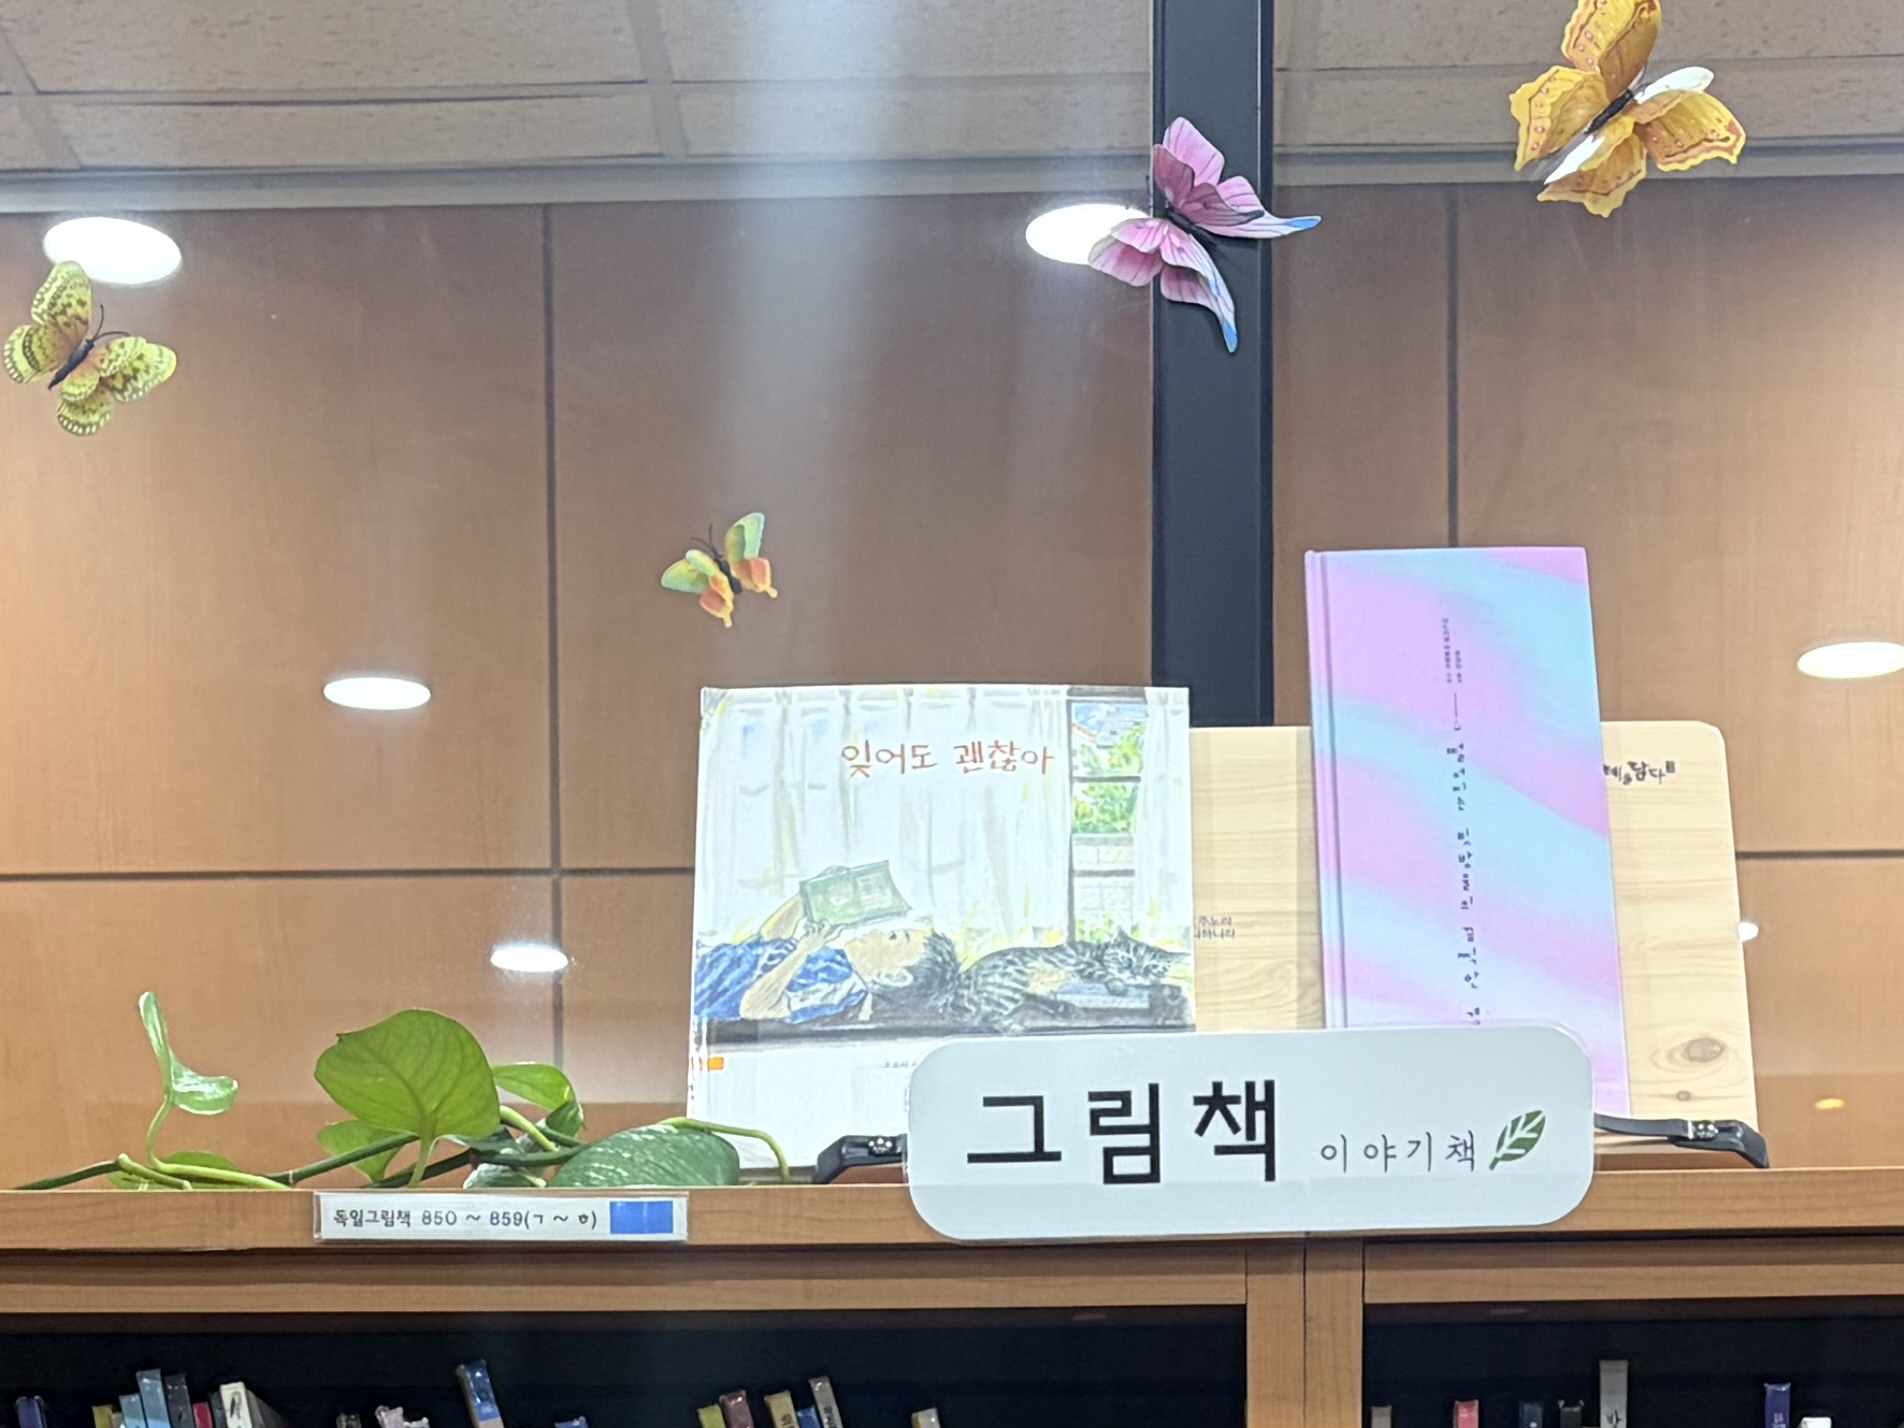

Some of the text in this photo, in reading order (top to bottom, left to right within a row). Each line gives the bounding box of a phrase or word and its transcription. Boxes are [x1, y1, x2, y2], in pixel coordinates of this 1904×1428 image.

[841, 739, 1056, 778] 잊어도 괜찮아
[967, 1080, 1277, 1185] 그림책
[333, 1207, 411, 1227] 독일그림책
[421, 1209, 458, 1226] 850
